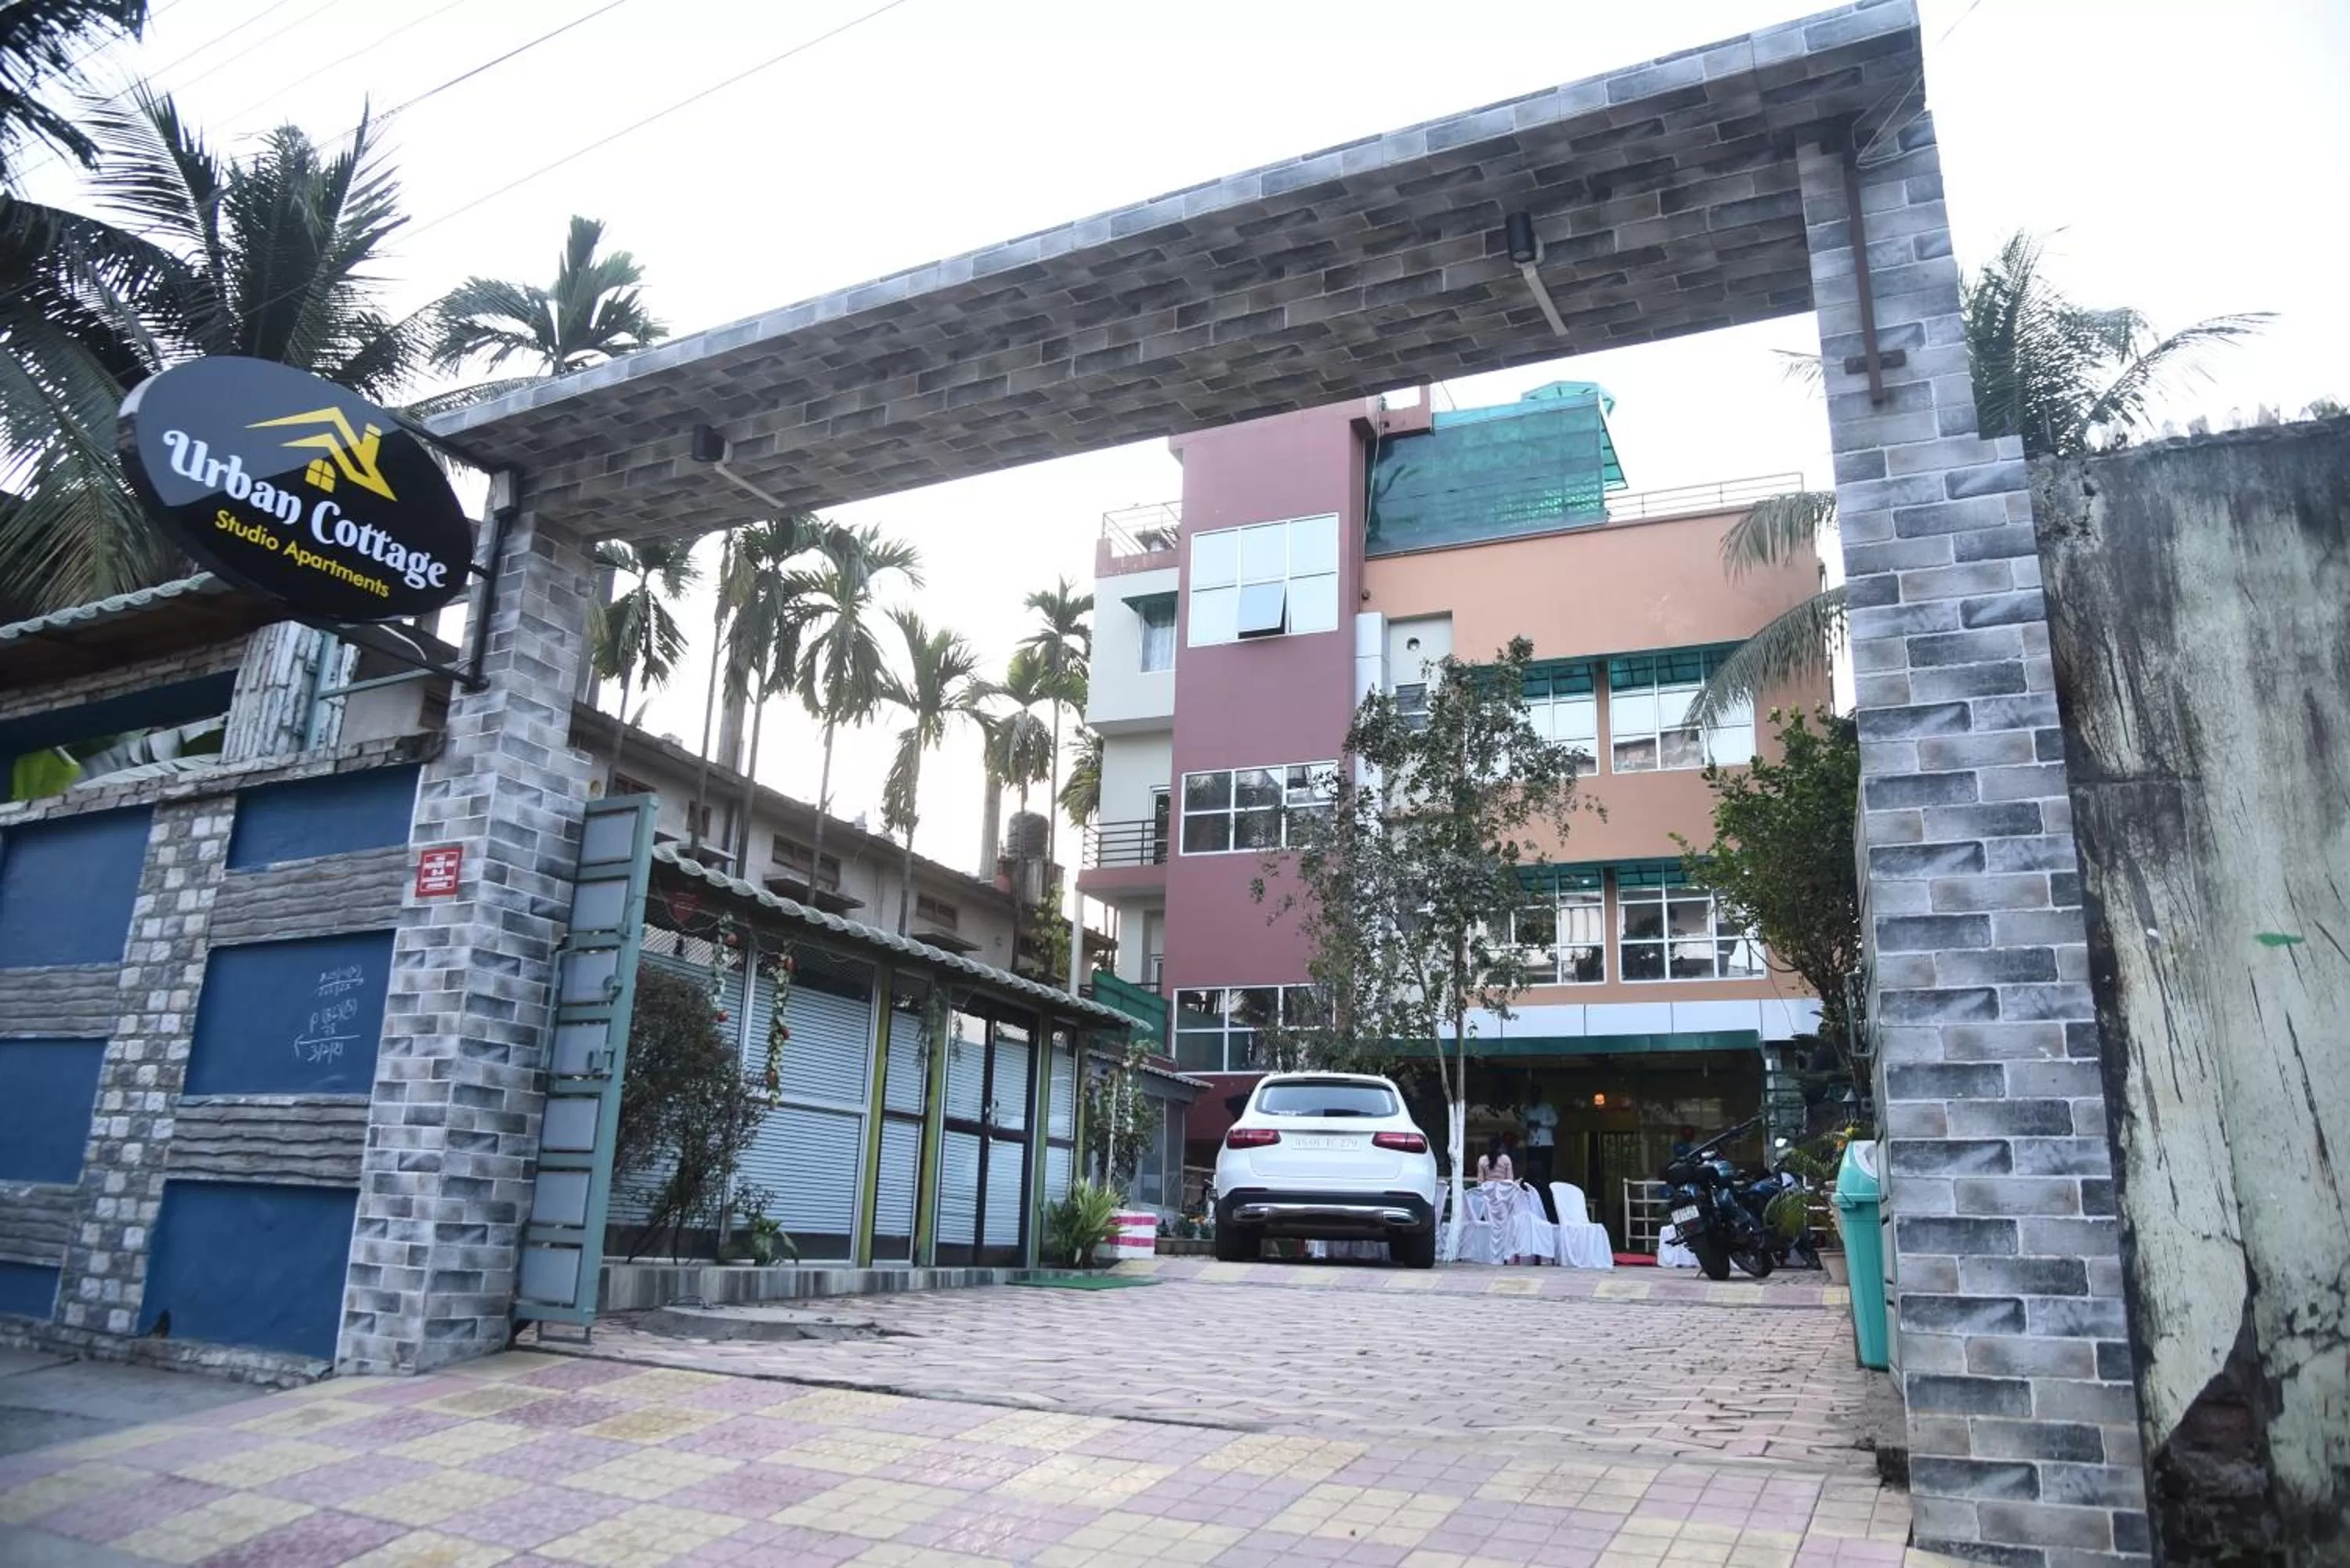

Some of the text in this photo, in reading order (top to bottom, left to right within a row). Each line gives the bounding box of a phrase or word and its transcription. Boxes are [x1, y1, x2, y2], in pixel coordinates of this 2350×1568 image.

[163, 430, 448, 590] Urban Cottage
[215, 510, 390, 598] Studio Apartments
